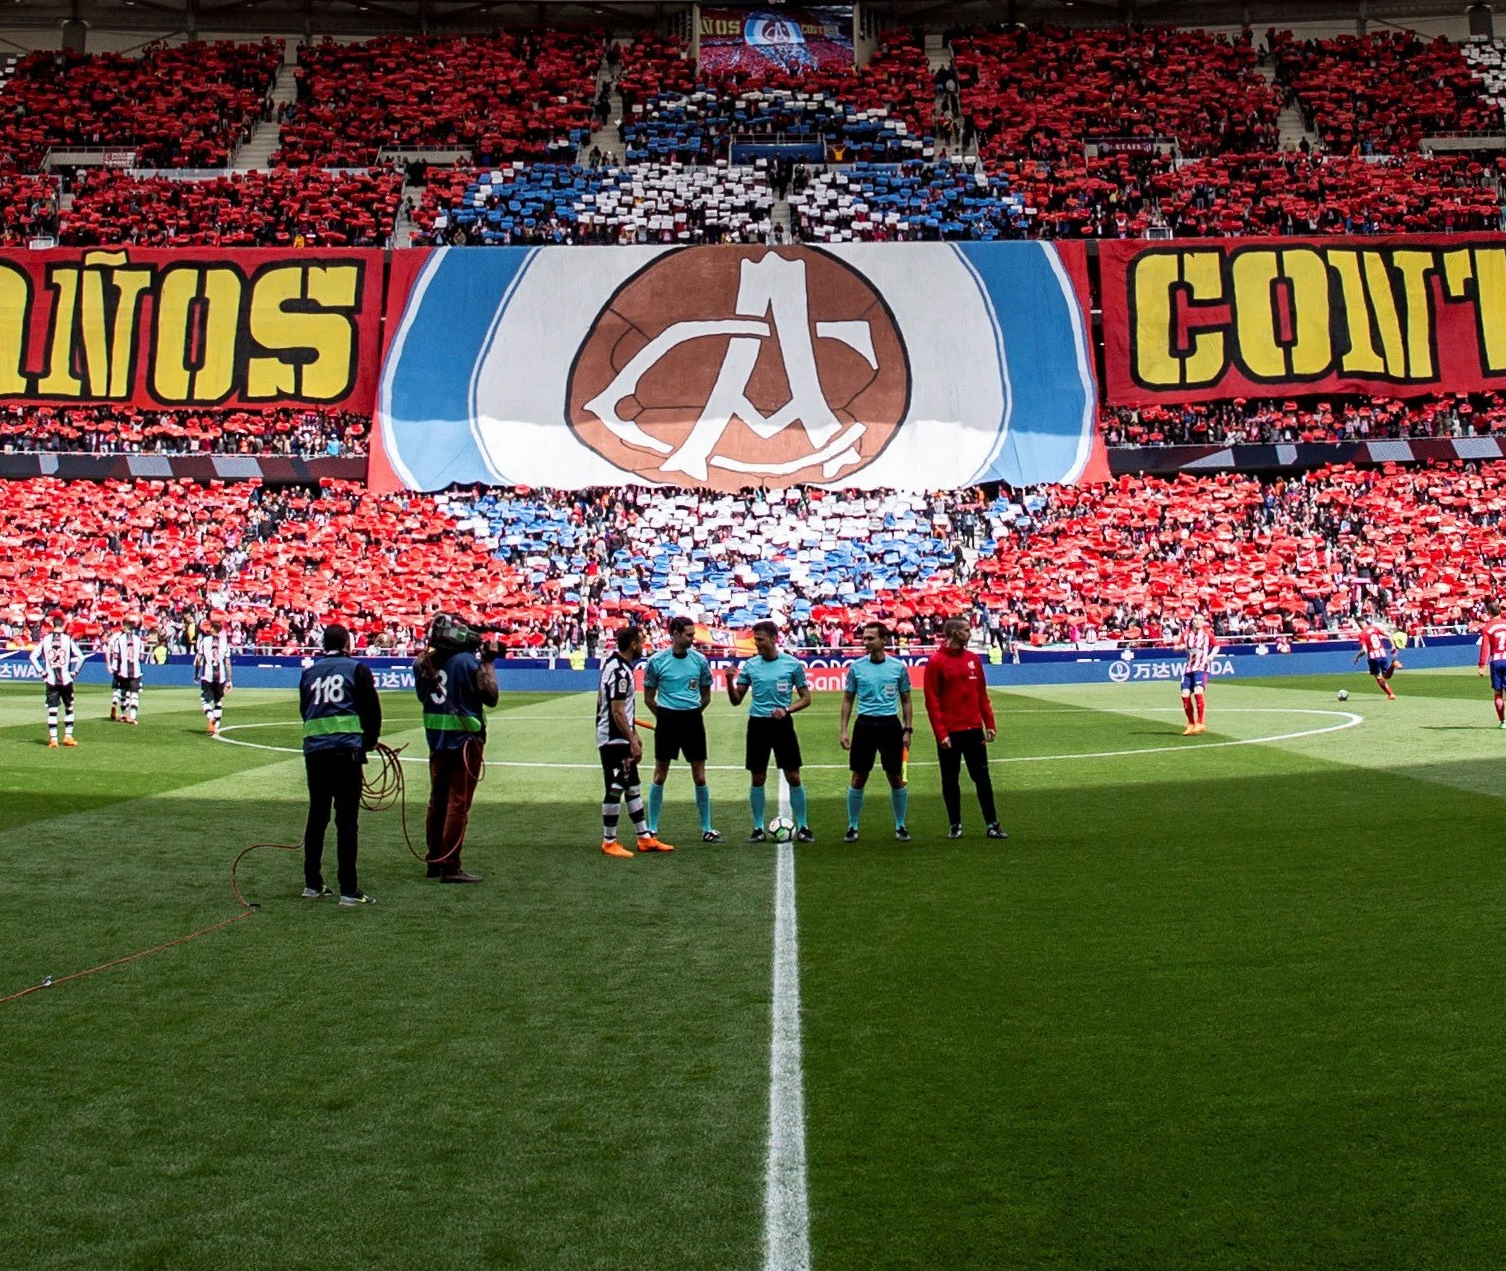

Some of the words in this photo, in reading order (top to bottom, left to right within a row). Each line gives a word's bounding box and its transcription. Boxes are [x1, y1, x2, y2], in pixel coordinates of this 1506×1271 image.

[1495, 631, 1506, 651] 7
[49, 649, 67, 667] 23
[310, 674, 345, 705] 118
